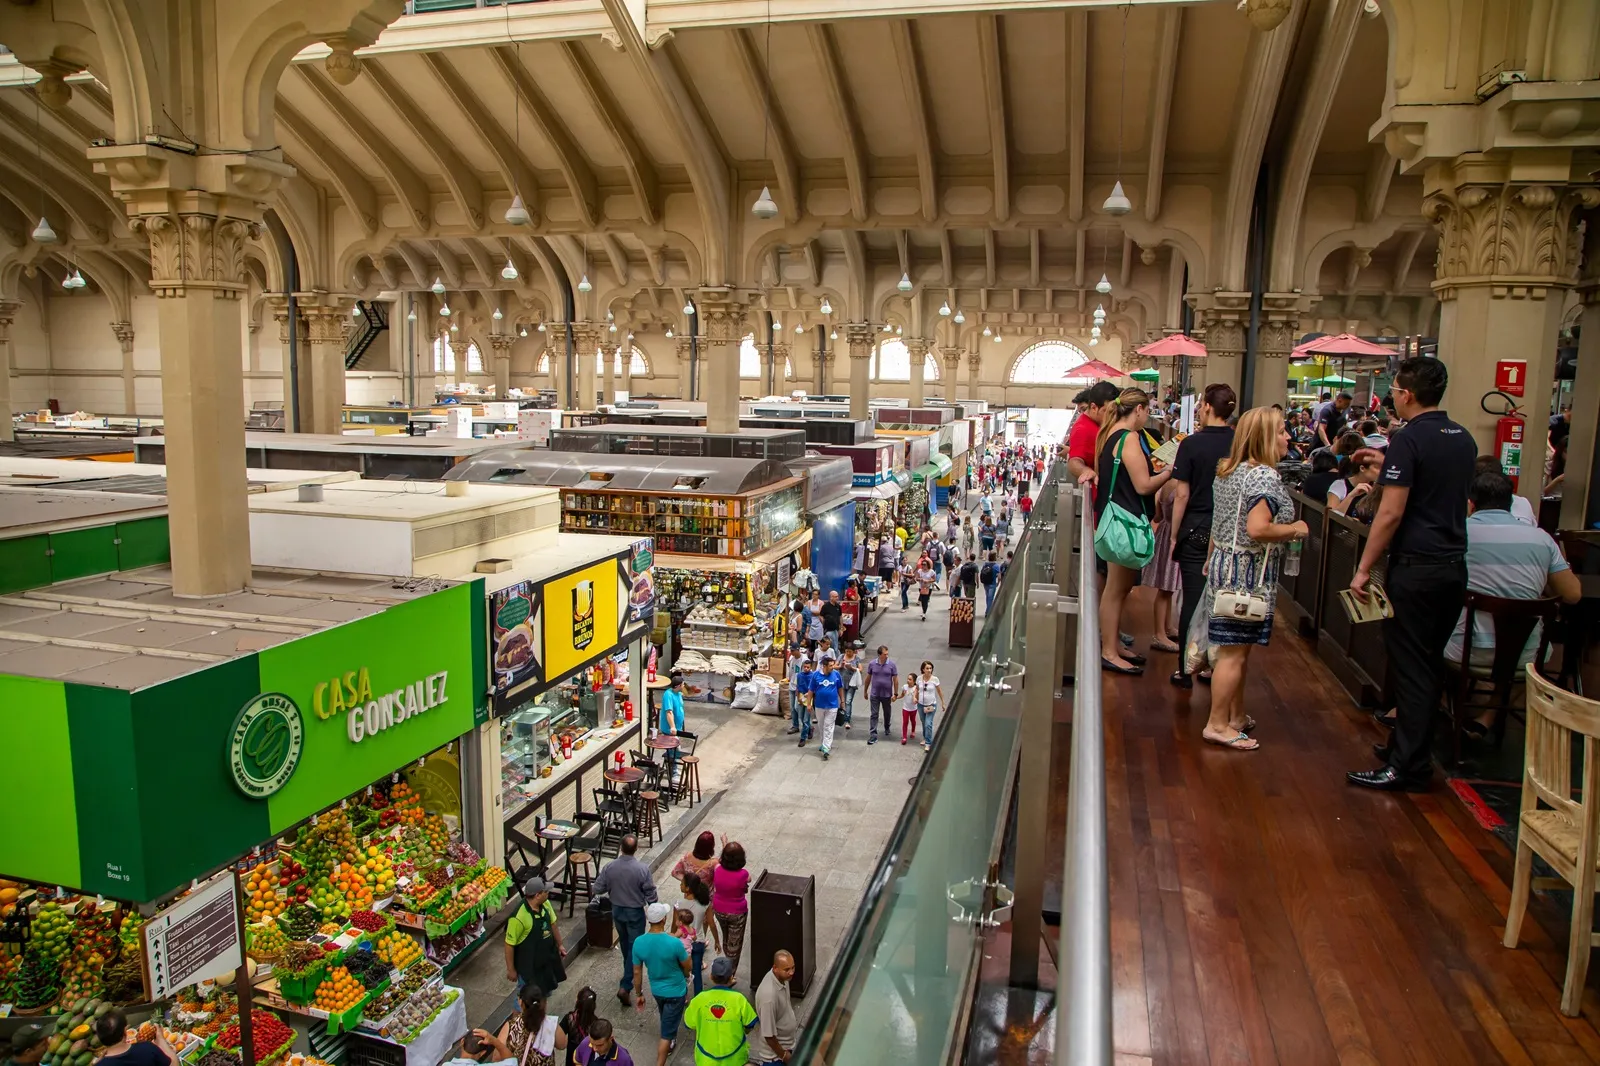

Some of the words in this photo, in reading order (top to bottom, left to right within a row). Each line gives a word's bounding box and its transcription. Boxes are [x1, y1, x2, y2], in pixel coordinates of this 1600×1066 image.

[313, 666, 373, 720] CASA
[347, 670, 448, 743] GONSALEZ
[106, 862, 119, 871] Rua
[107, 870, 122, 880] Boxe
[148, 925, 163, 938] Rua
[167, 927, 183, 939] Frutas
[169, 952, 180, 961] Rua
[180, 947, 186, 955] 25
[192, 933, 207, 945] Março
[171, 964, 181, 973] Rua
[181, 959, 188, 967] da
[187, 943, 211, 962] Cantareira
[172, 973, 186, 985] Caixa
[186, 967, 192, 976] 24
[192, 958, 205, 970] horas
